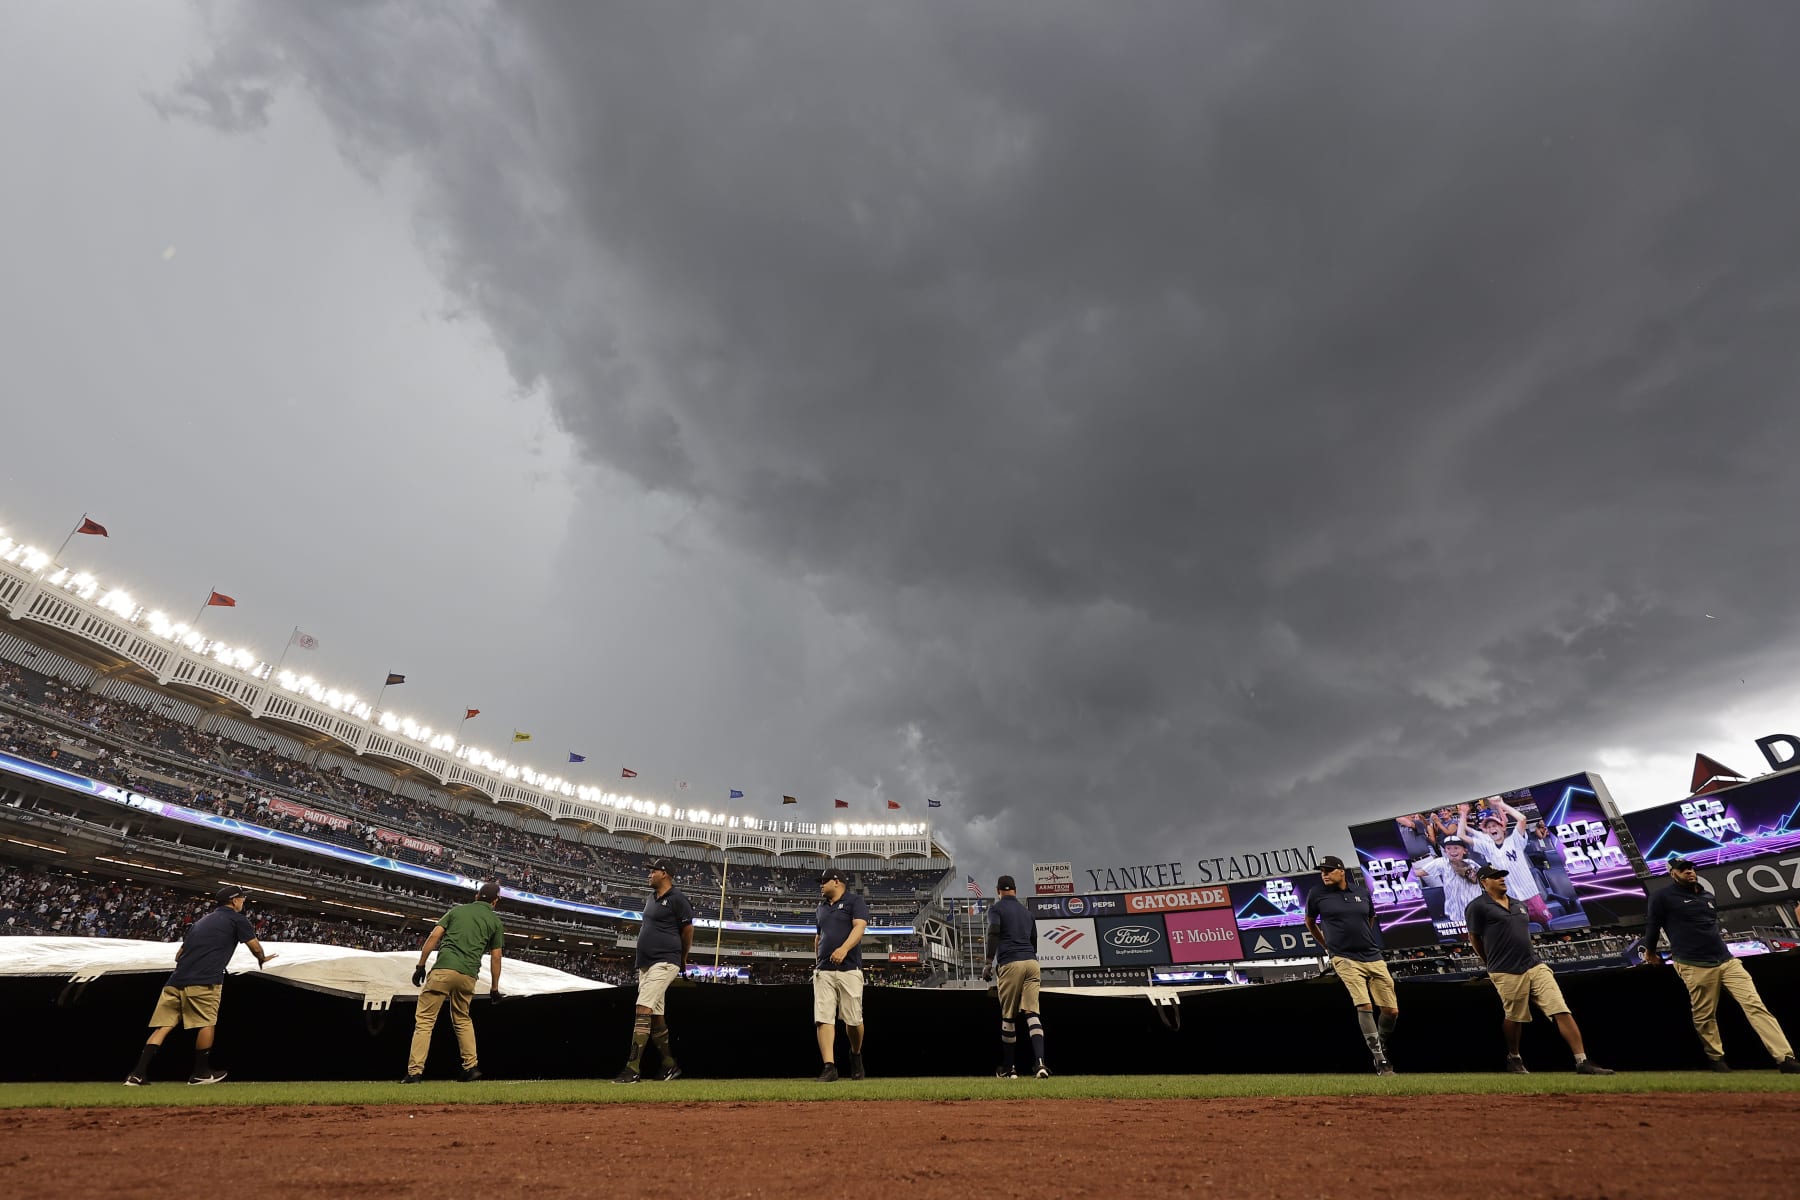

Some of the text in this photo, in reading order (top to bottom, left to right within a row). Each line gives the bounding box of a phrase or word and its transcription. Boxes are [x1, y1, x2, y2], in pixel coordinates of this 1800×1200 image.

[304, 810, 348, 830] PARTY DECK
[1555, 820, 1608, 842] 80s
[404, 838, 424, 850] PARTY
[1086, 845, 1320, 891] YANKEE STADIUM
[1368, 858, 1409, 876] 80s
[1563, 841, 1628, 874] 8th
[1131, 889, 1226, 910] GATORADE
[1372, 877, 1424, 904] 8th
[1114, 928, 1151, 944] Ford
[1187, 927, 1235, 943] Mobile
[1280, 929, 1324, 950] DE
